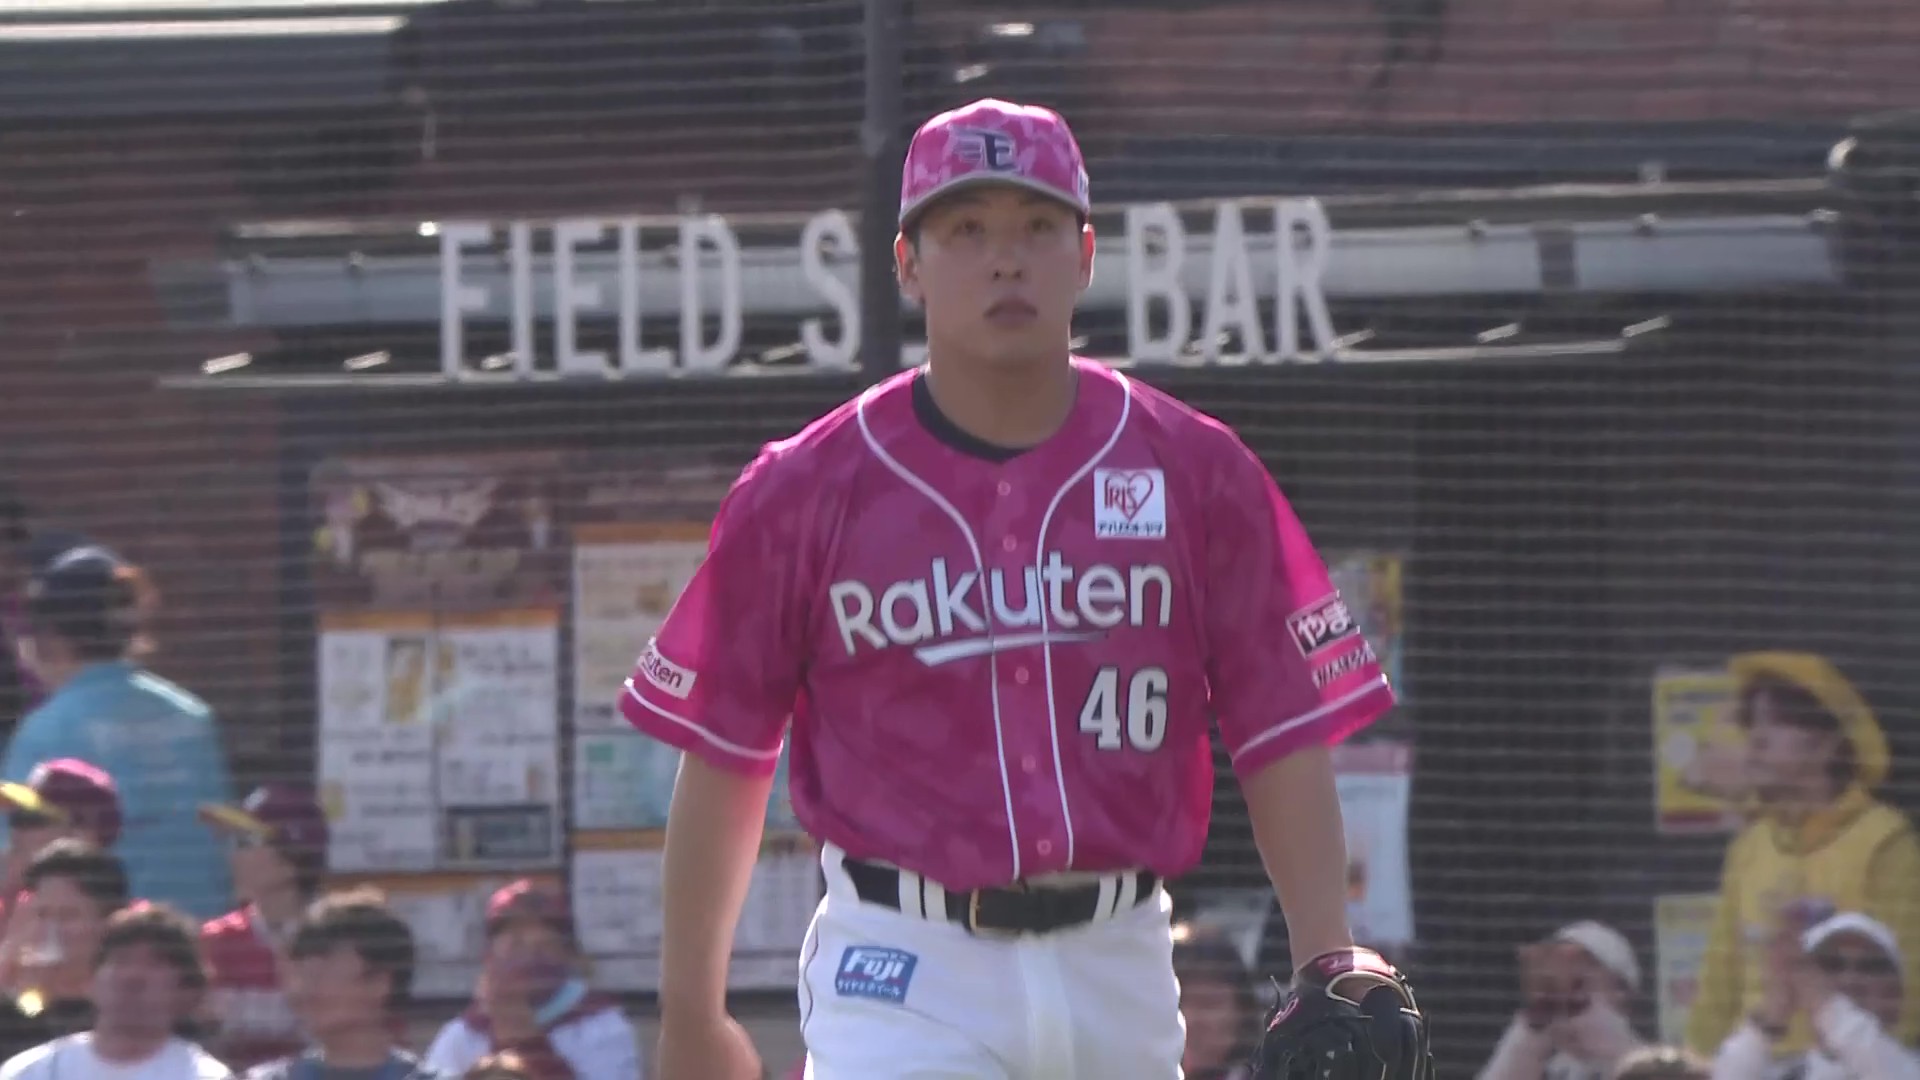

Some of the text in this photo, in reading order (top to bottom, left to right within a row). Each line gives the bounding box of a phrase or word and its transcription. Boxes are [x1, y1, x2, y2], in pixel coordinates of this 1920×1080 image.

[441, 220, 742, 379] FIELD
[1126, 198, 1336, 364] BAR
[1104, 474, 1142, 513] IRIS
[829, 551, 1173, 656] Rakuten
[1078, 666, 1169, 751] 46
